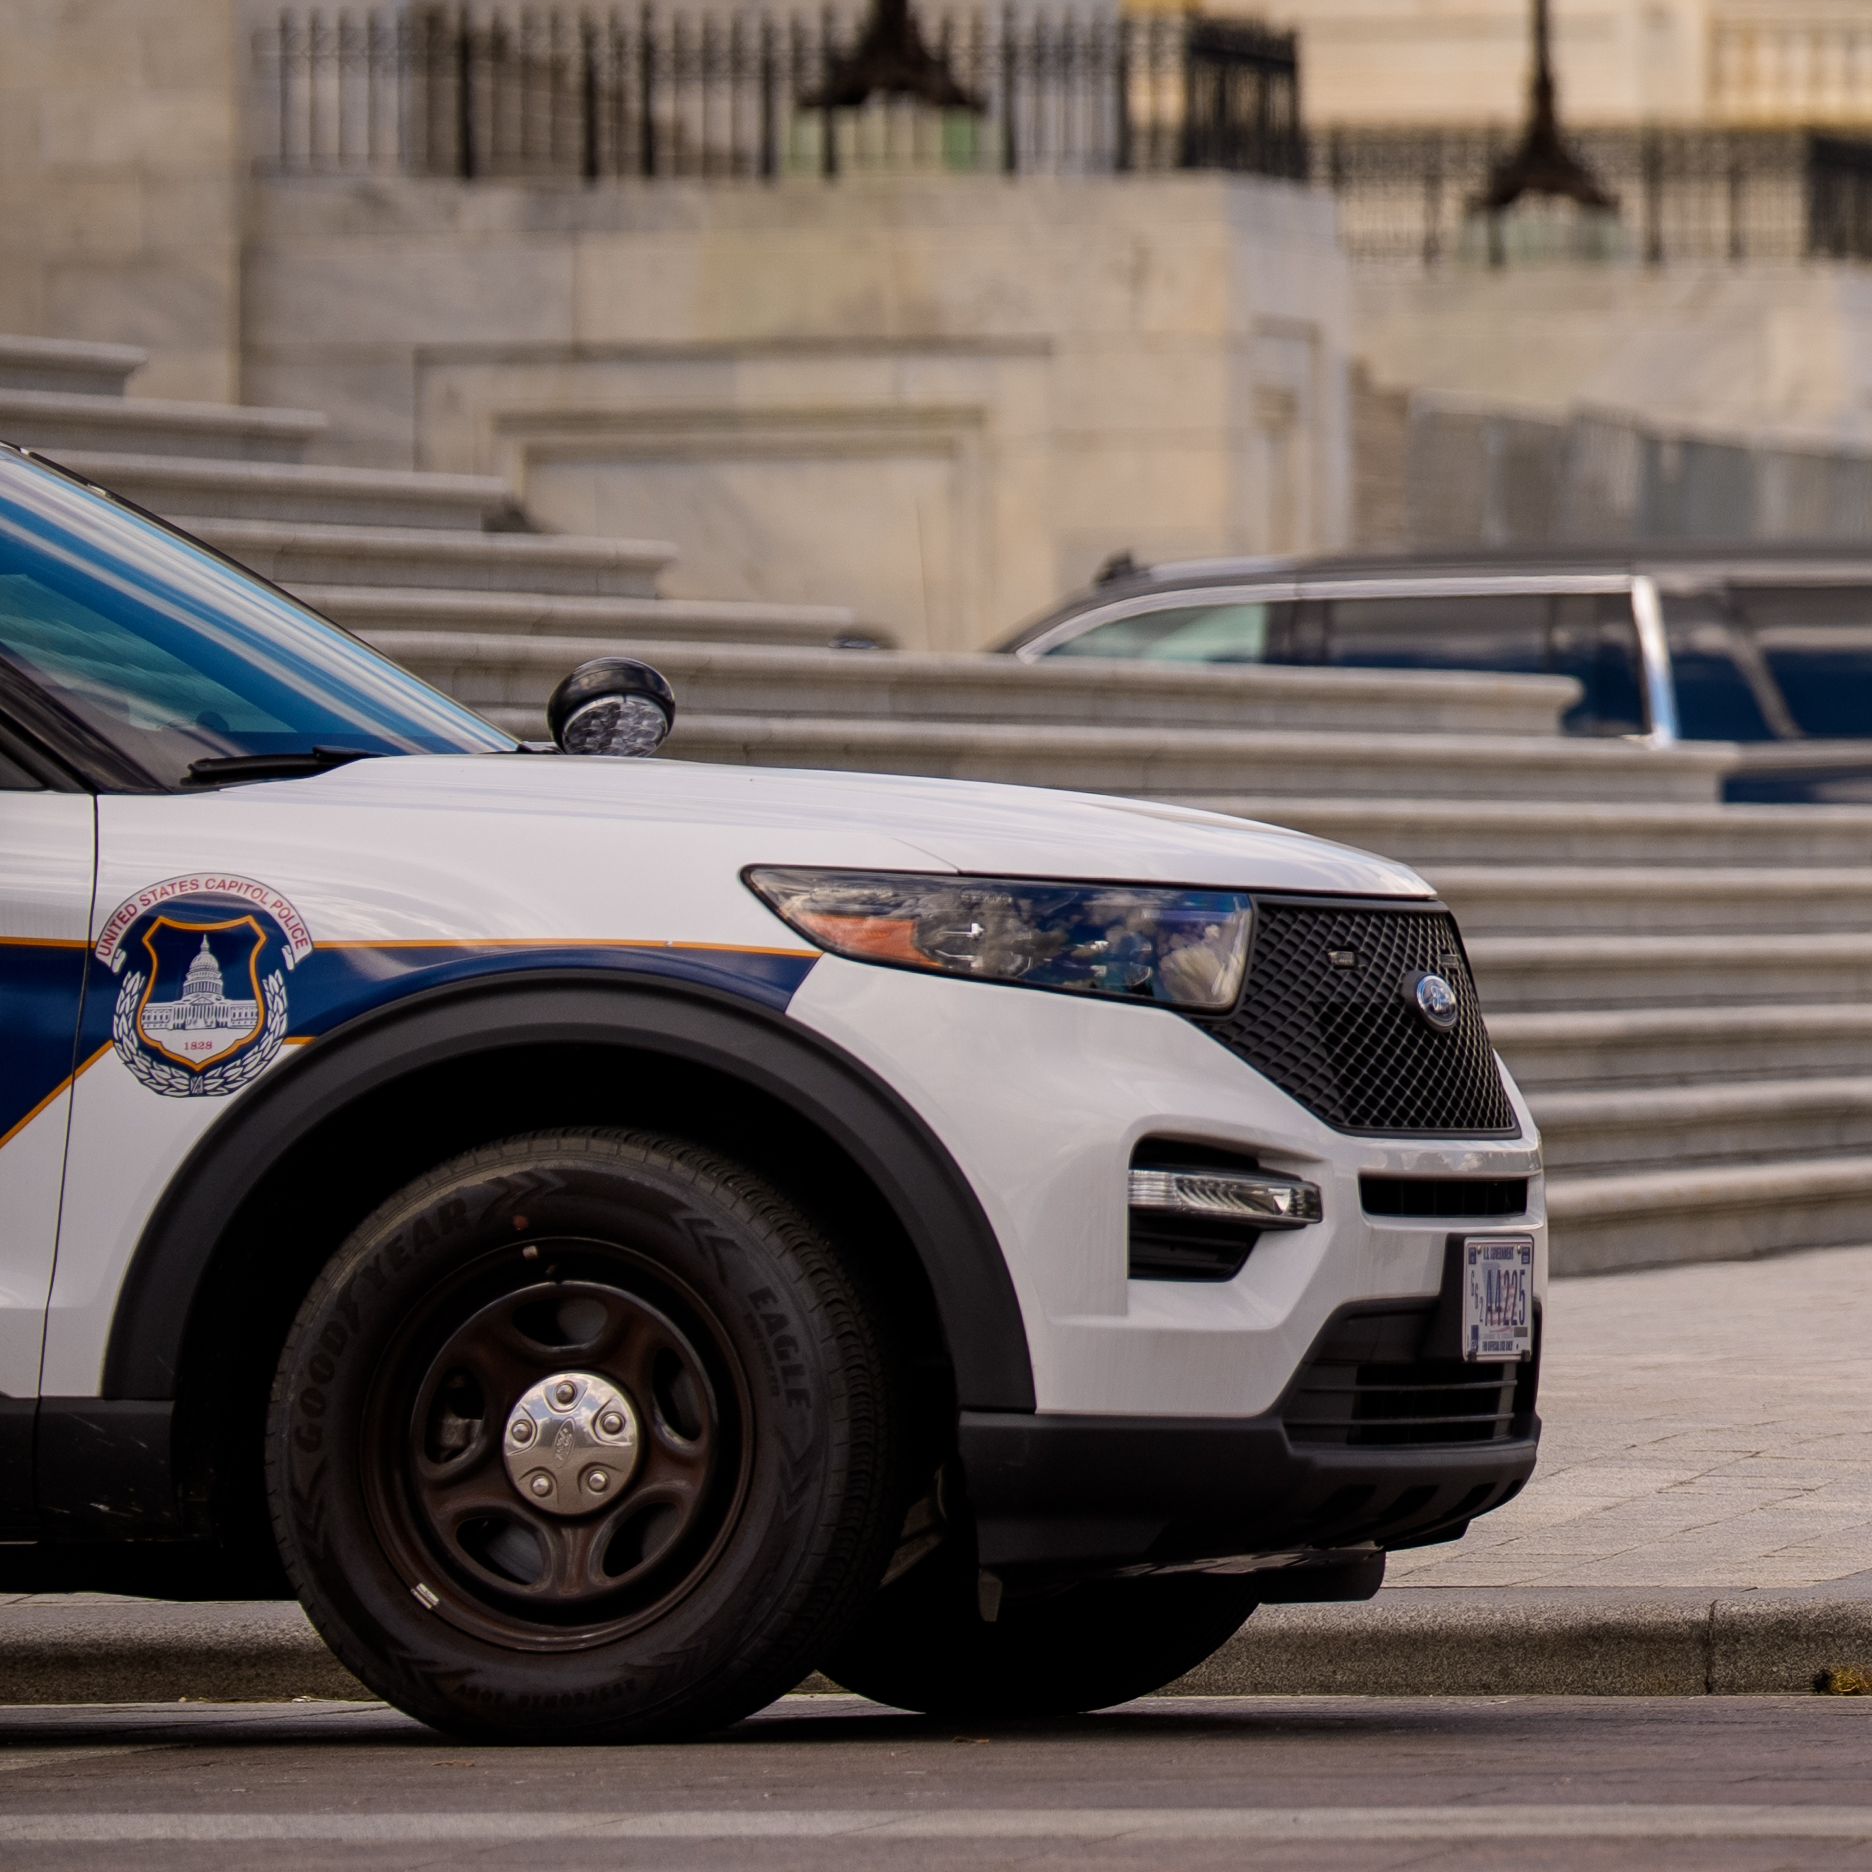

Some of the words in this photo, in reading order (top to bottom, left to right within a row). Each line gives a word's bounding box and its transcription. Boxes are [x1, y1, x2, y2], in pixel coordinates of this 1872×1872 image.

[97, 902, 138, 958] UNITED
[139, 878, 200, 907] STATES
[204, 878, 268, 905] CAPITOL
[271, 899, 309, 950] POLICE
[184, 1040, 213, 1050] 1828
[1485, 1269, 1526, 1326] A4225
[748, 1286, 813, 1409] EAGLE
